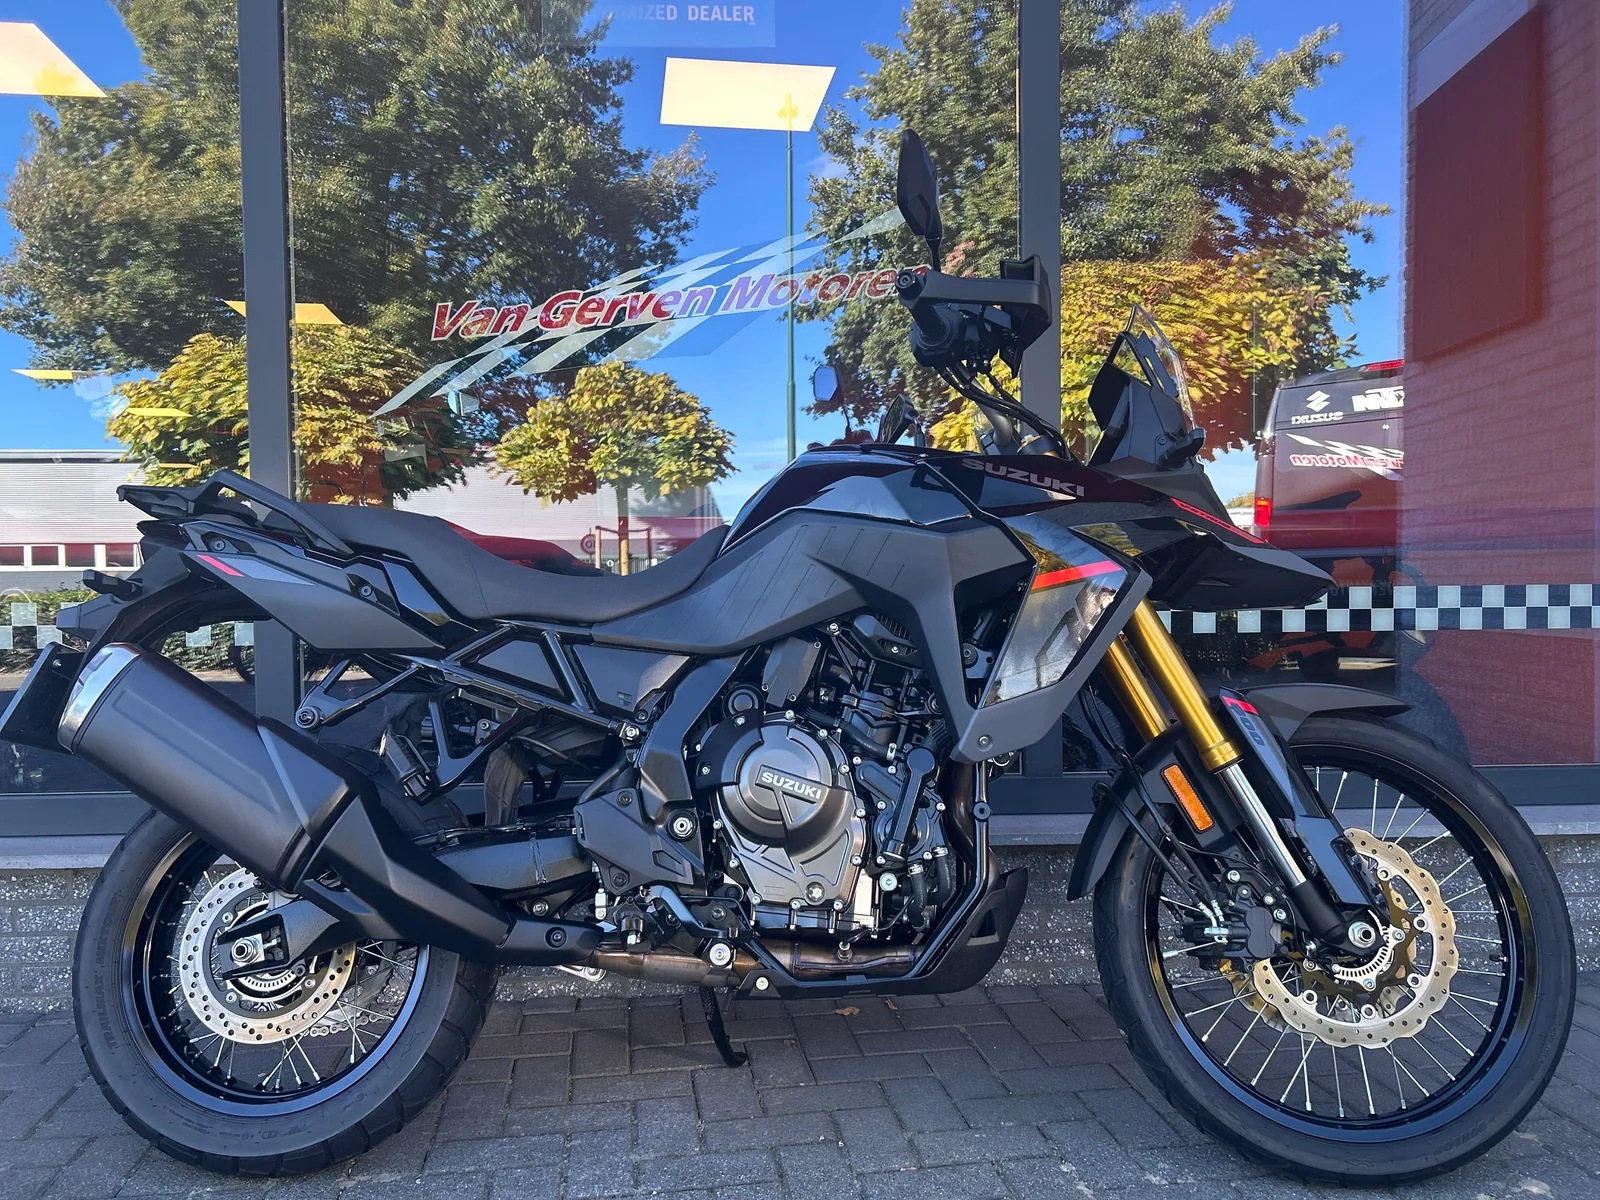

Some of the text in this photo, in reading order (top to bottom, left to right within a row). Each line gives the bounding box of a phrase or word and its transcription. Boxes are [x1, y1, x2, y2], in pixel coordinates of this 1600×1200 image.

[687, 5, 756, 21] DEALER
[431, 300, 531, 340] Van
[538, 285, 718, 331] Gerven
[961, 457, 1085, 497] SUZUKI
[761, 771, 822, 799] SUZUKI
[94, 974, 117, 1050] TRAILMAX
